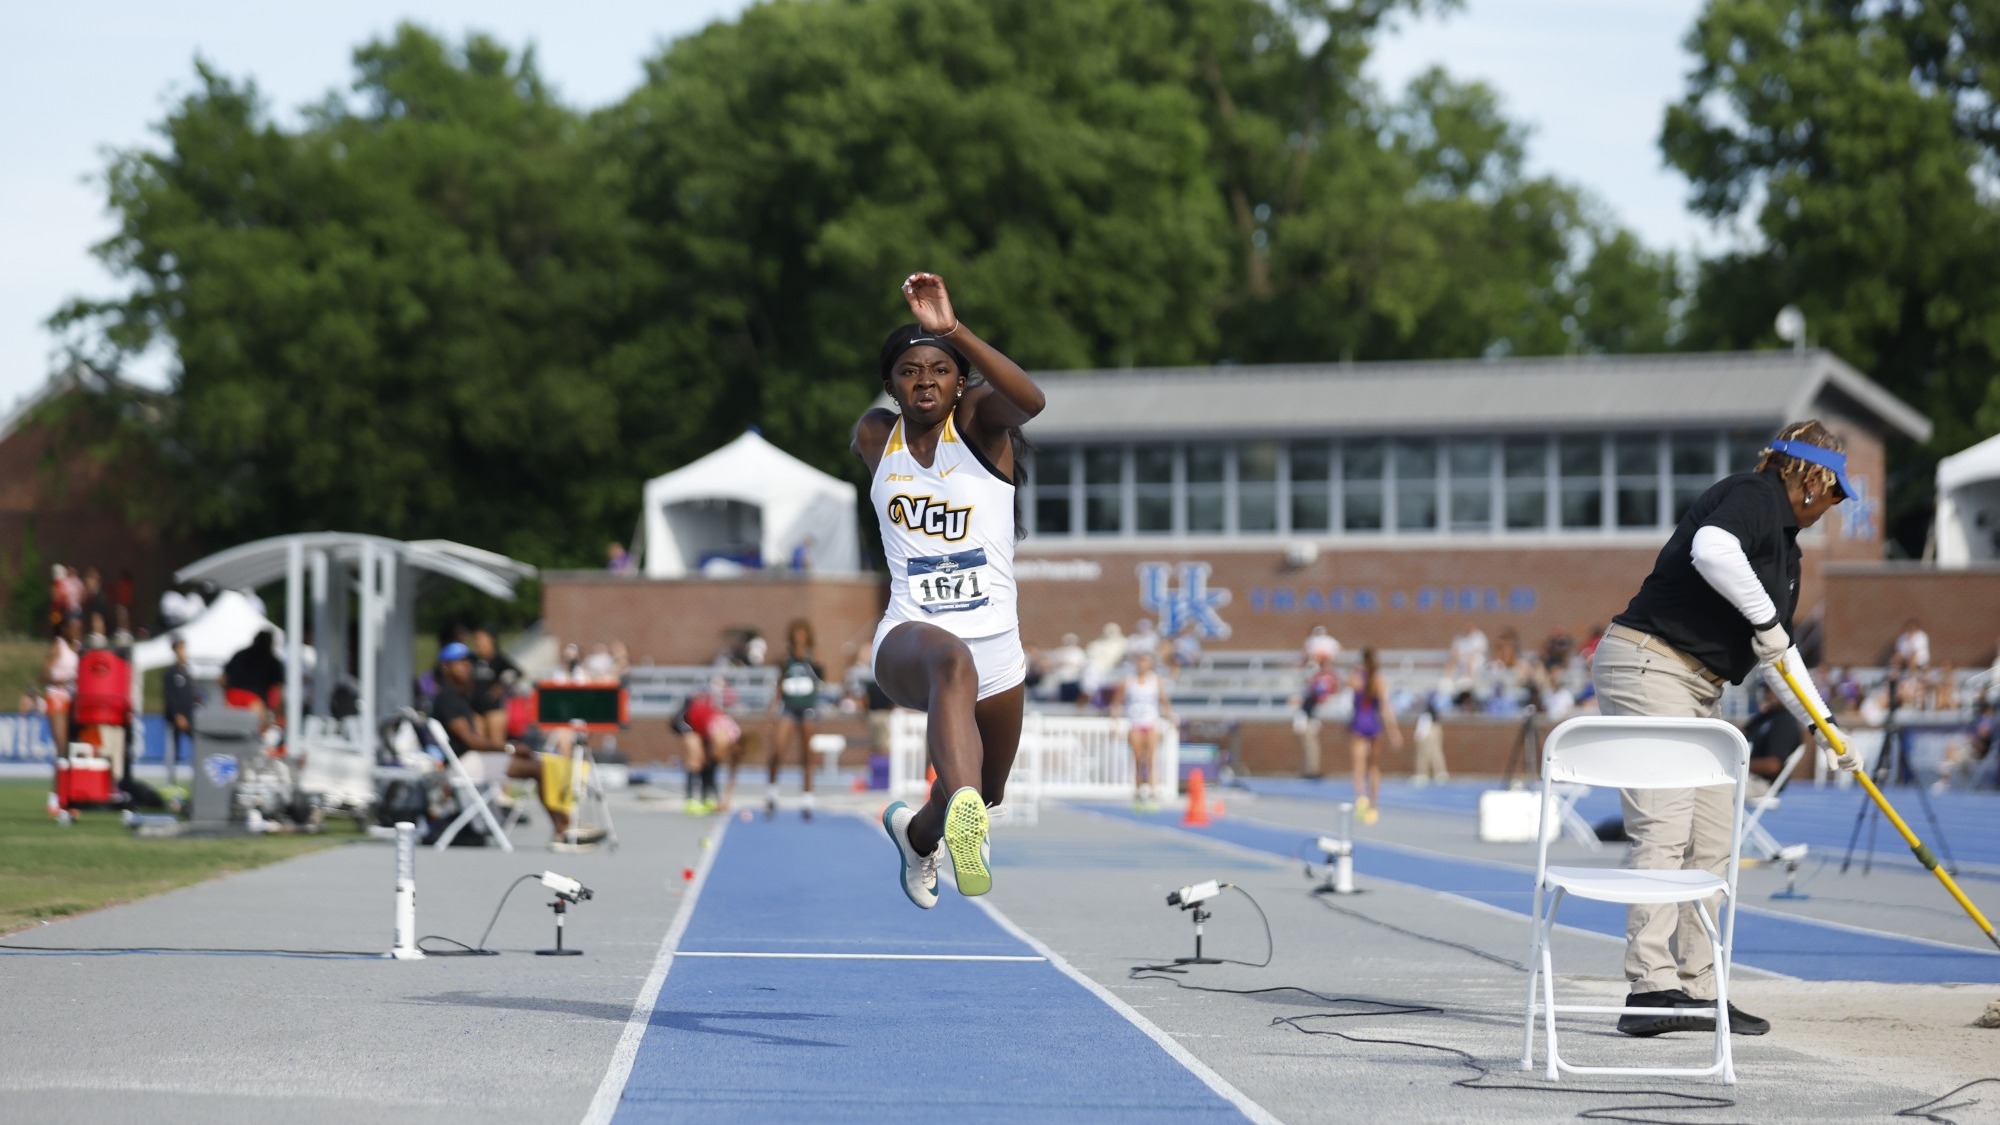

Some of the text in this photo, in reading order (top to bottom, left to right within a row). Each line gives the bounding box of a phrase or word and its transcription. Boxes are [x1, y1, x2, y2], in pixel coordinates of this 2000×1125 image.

[888, 493, 974, 542] VCU
[920, 571, 982, 602] 1671
[1137, 562, 1231, 640] UK
[1250, 587, 1377, 614] TRACK
[1415, 587, 1538, 614] FIELD
